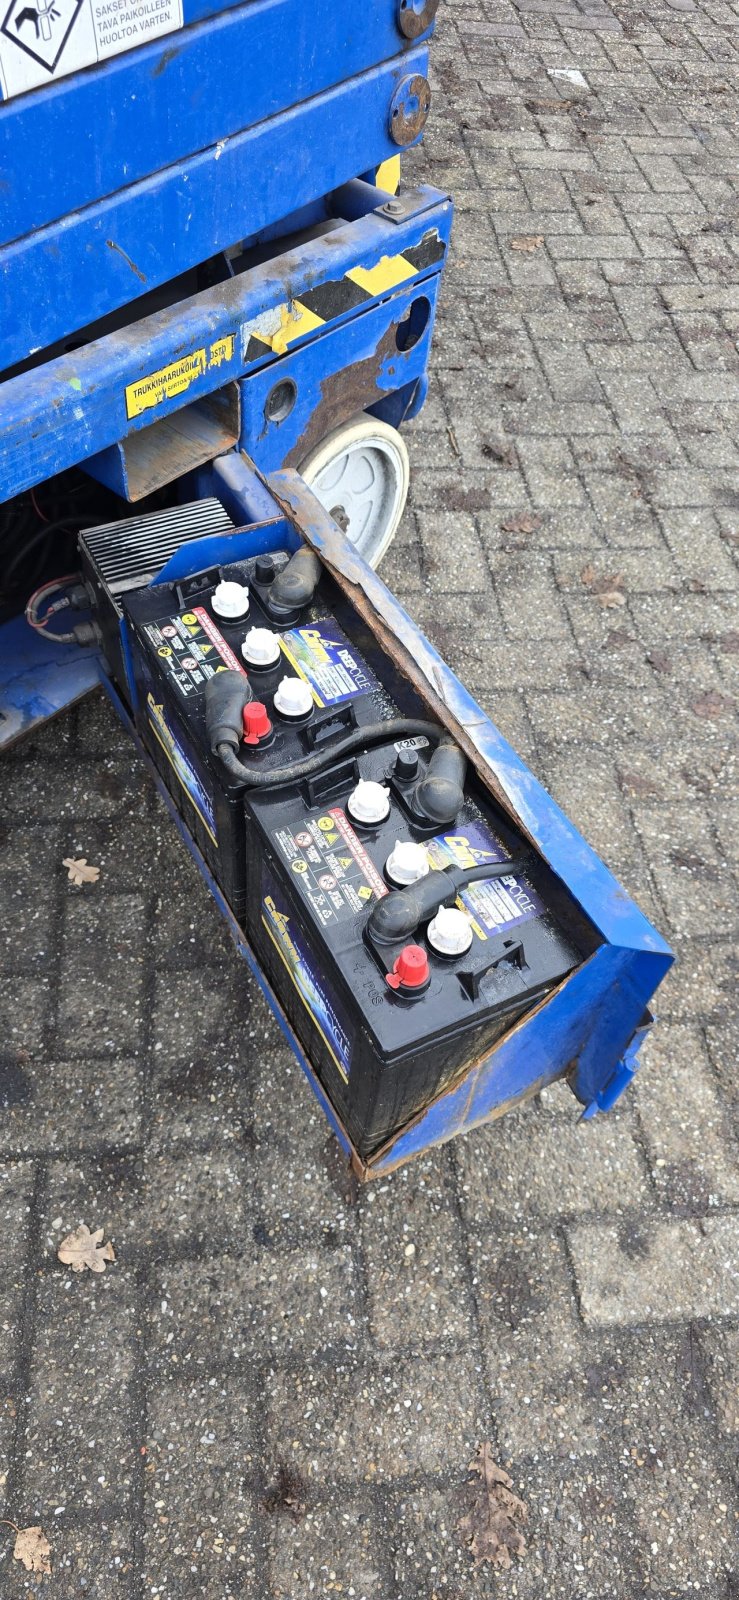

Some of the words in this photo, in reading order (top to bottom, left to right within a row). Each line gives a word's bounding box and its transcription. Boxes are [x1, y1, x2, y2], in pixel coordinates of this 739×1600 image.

[97, 16, 118, 32] TAVA
[119, 0, 171, 23] PAIKOILLEEN
[99, 25, 138, 46] HUOLTOA
[139, 11, 173, 30] VARTEN.
[337, 649, 371, 690] DEEPCYCLE
[397, 738, 416, 749] K20
[338, 817, 387, 894] DANGER/POISON
[263, 895, 300, 962] CROWN
